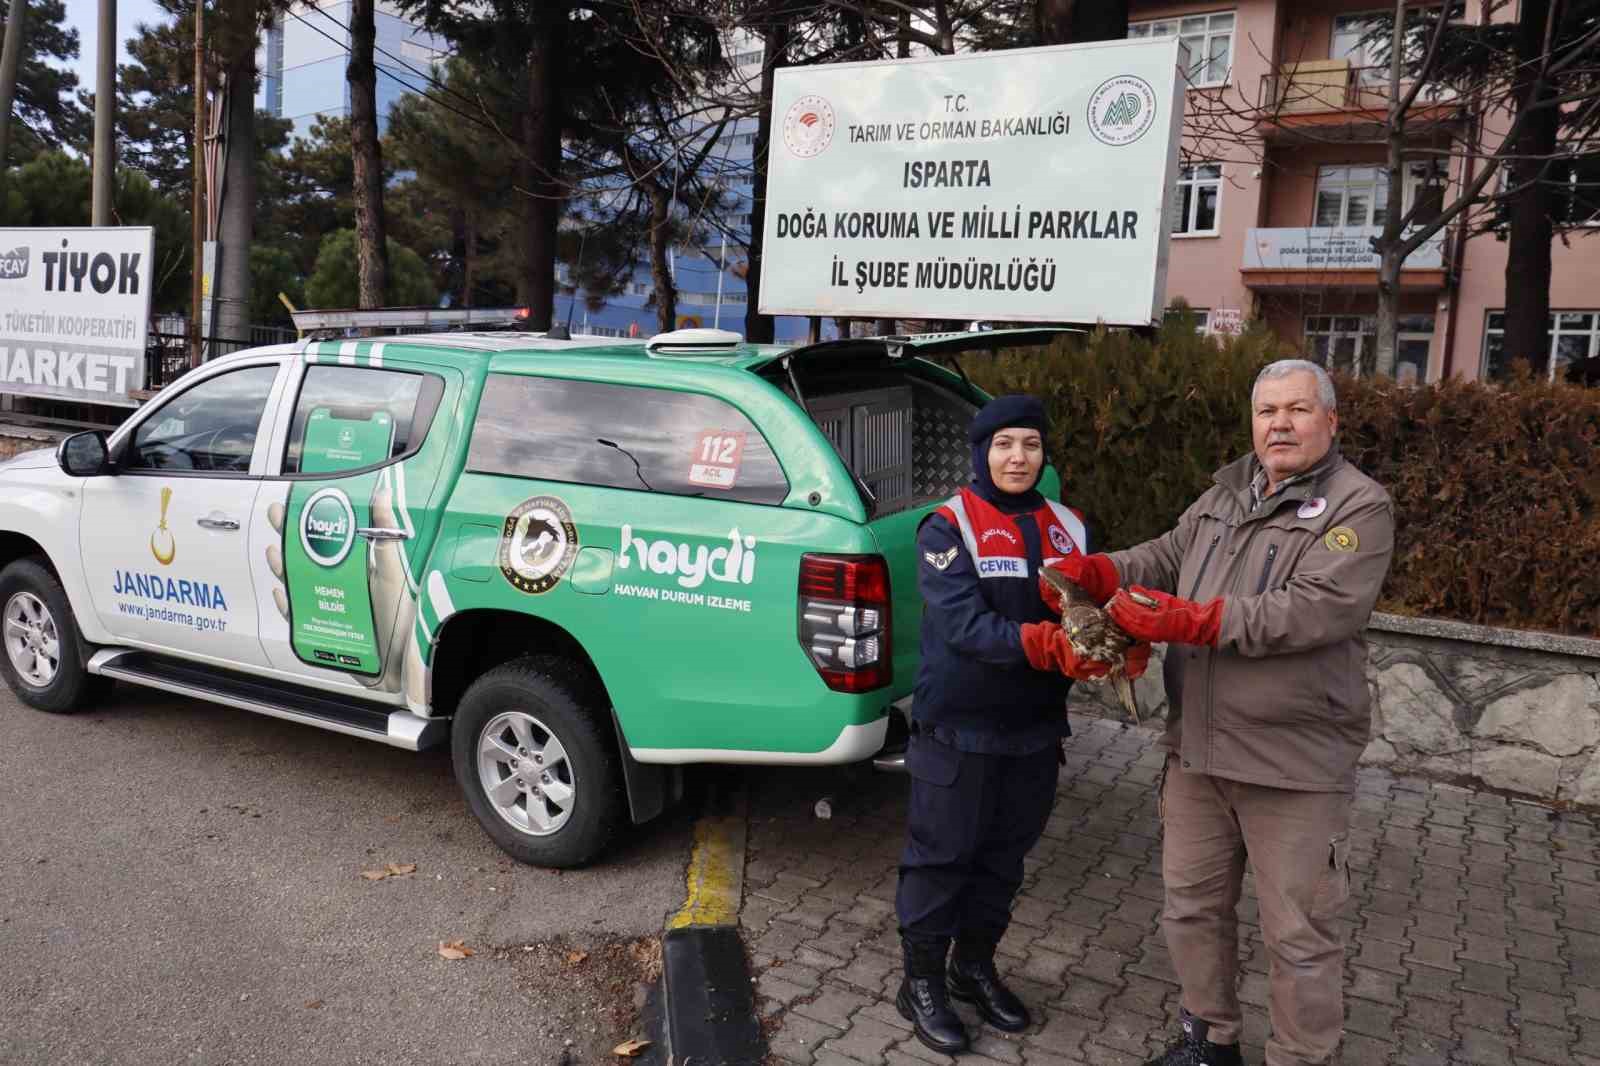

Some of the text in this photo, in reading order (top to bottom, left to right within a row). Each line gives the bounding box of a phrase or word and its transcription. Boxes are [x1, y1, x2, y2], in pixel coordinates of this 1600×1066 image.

[944, 94, 969, 112] T.C.
[849, 124, 891, 143] TARIM
[897, 123, 915, 141] VE
[919, 119, 976, 140] ORMAN
[981, 111, 1070, 137] BAKANLIĞI
[904, 160, 991, 188] ISPARTA
[776, 204, 1138, 239] DOĞA KORUMA VE MİLLİ PARKLAR
[42, 238, 141, 294] TİYOK
[831, 254, 1056, 294] İL ŞUBE MÜDÜRLÜĞÜ
[5, 308, 137, 340] TÜKETİM KOOPERATİFİ
[701, 436, 736, 464] 112
[619, 524, 756, 588] haydi
[980, 559, 1018, 574] ÇEVRE
[113, 570, 228, 611] JANDARMA
[614, 583, 659, 599] HAYVAN
[661, 590, 704, 606] DURUM
[118, 601, 227, 631] www.jandarma.gov.tr
